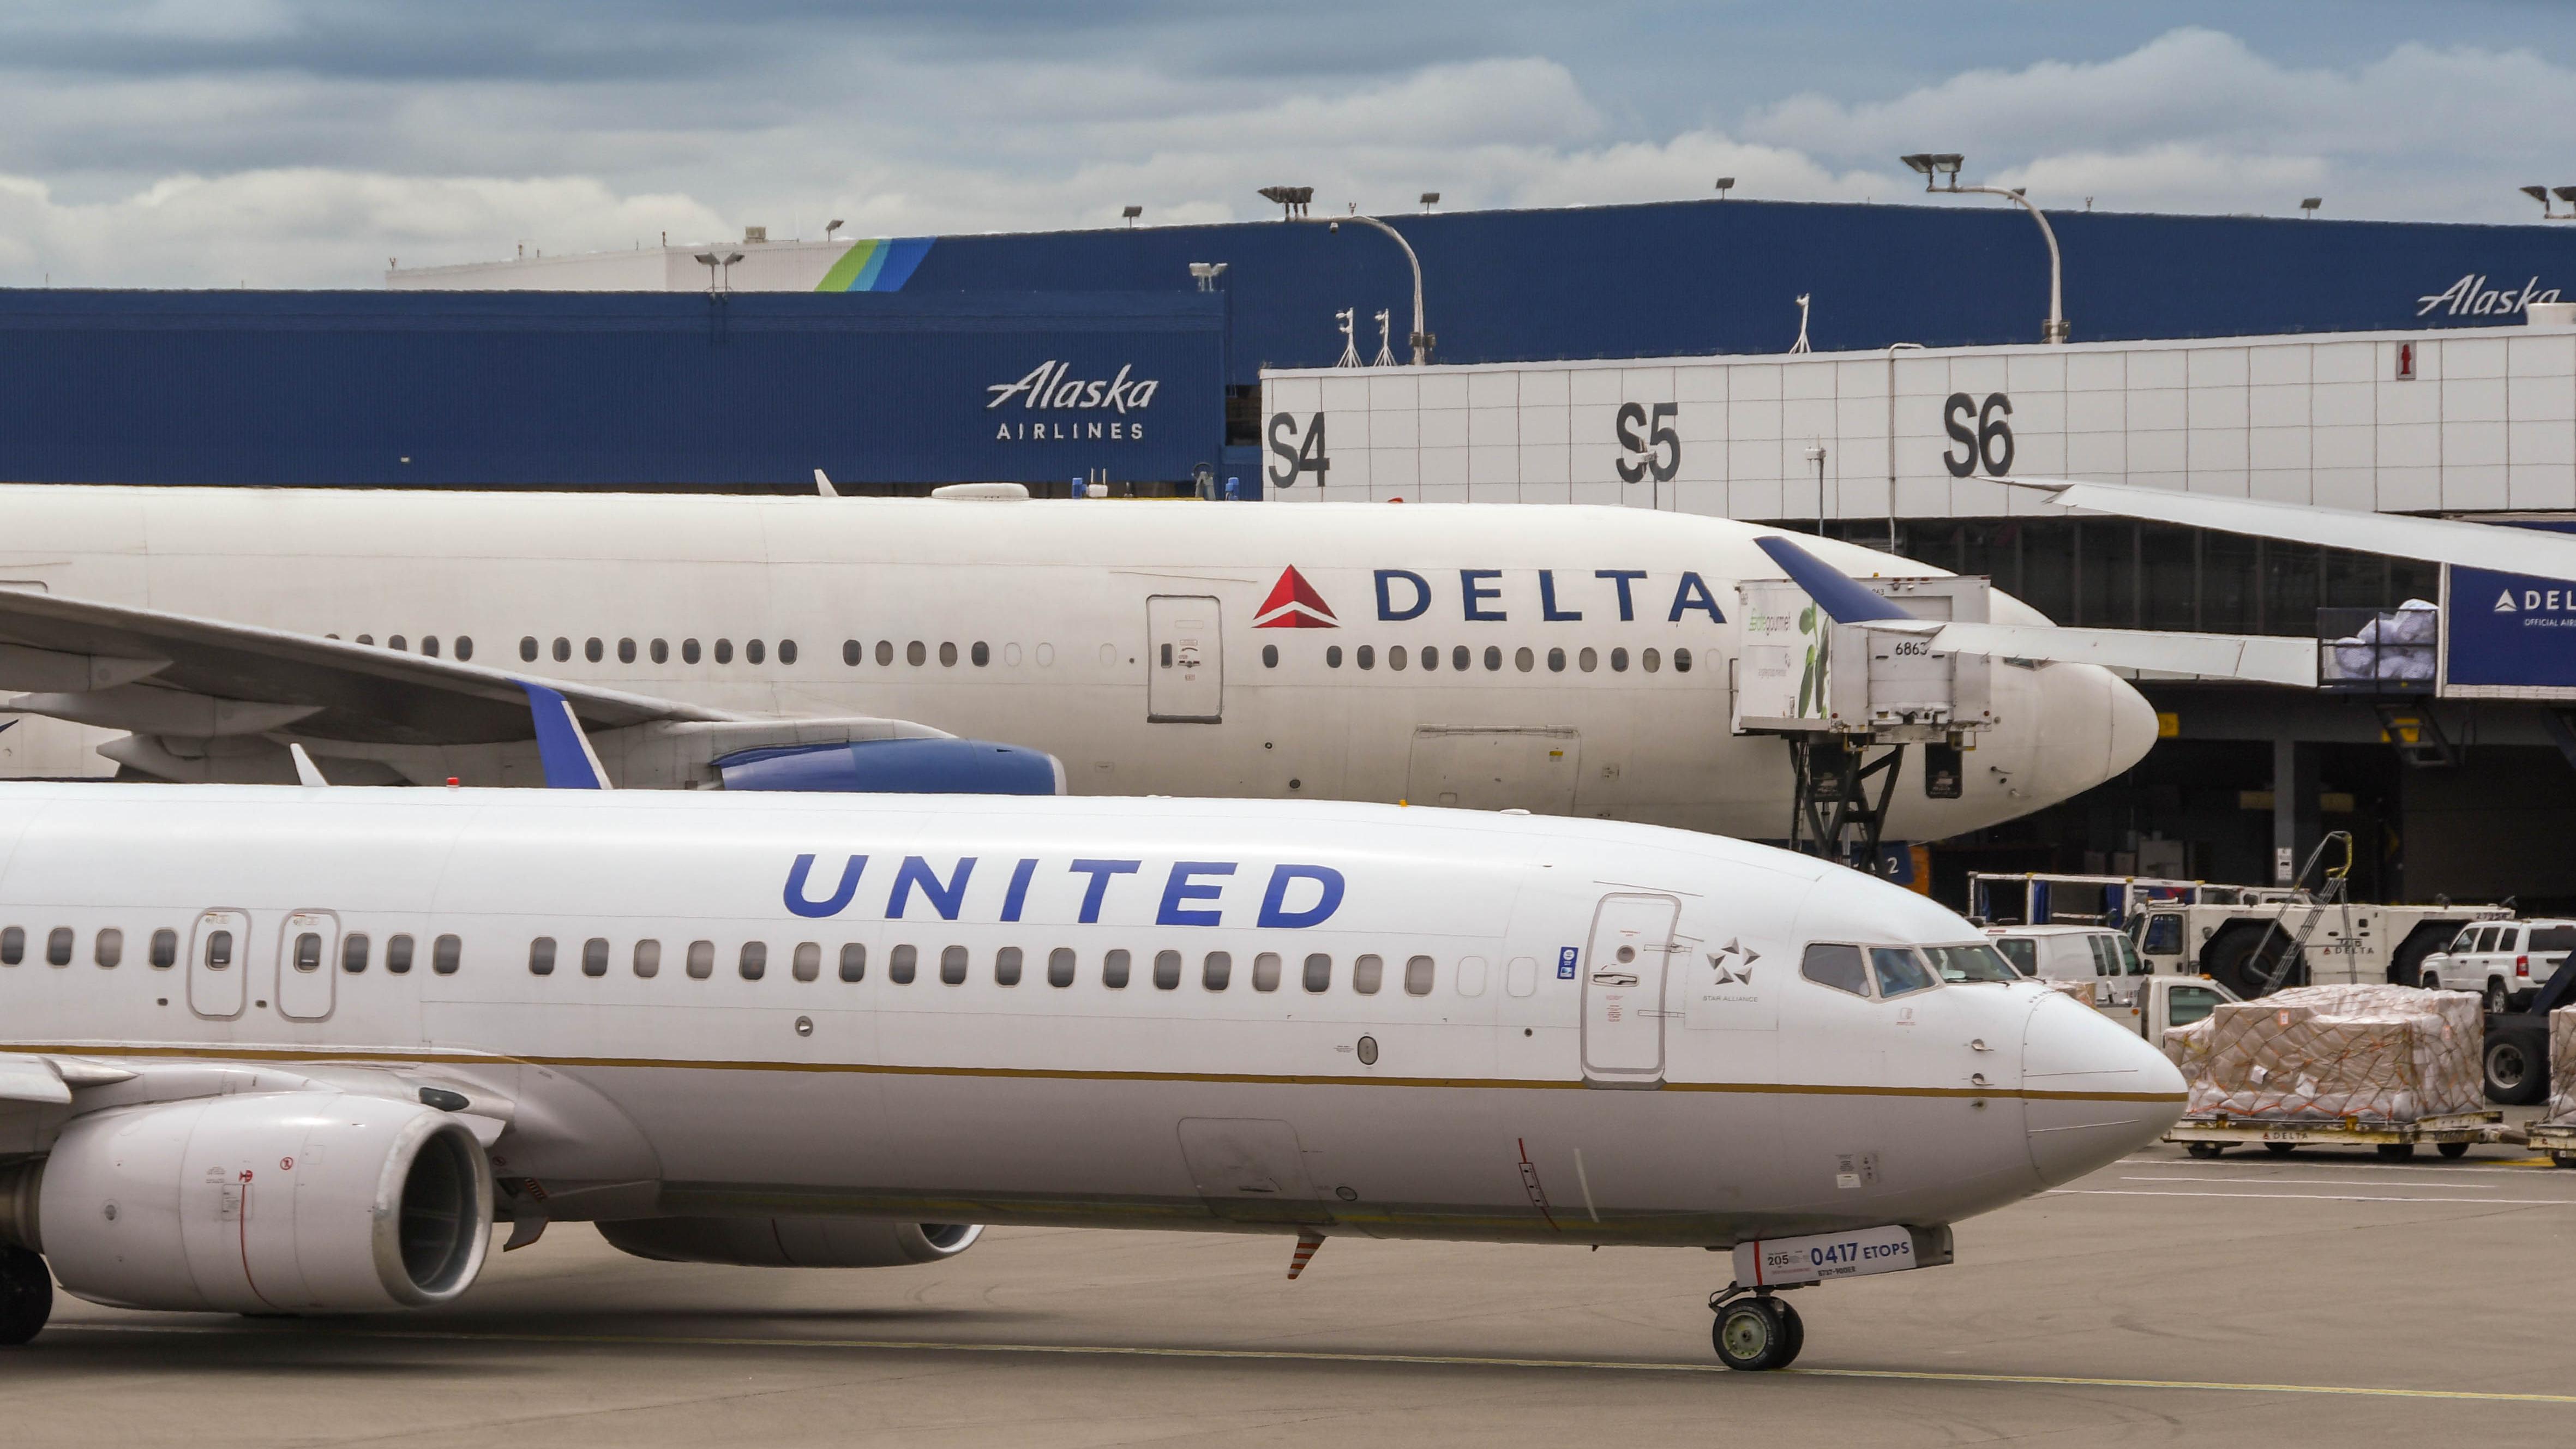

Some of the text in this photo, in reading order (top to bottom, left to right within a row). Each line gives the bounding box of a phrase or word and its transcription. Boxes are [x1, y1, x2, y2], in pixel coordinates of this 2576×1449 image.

[986, 359, 1159, 414] Alaska
[996, 422, 1143, 440] AIRLINES
[1268, 411, 1330, 488] S4
[1616, 401, 1681, 484] S5
[1943, 392, 2015, 478] S6
[1373, 569, 1727, 623] DELTA
[2525, 618, 2559, 627] OFFICIAL
[783, 853, 1346, 929] UNITED
[1767, 1242, 1910, 1266] 205 0417 ETOPS
